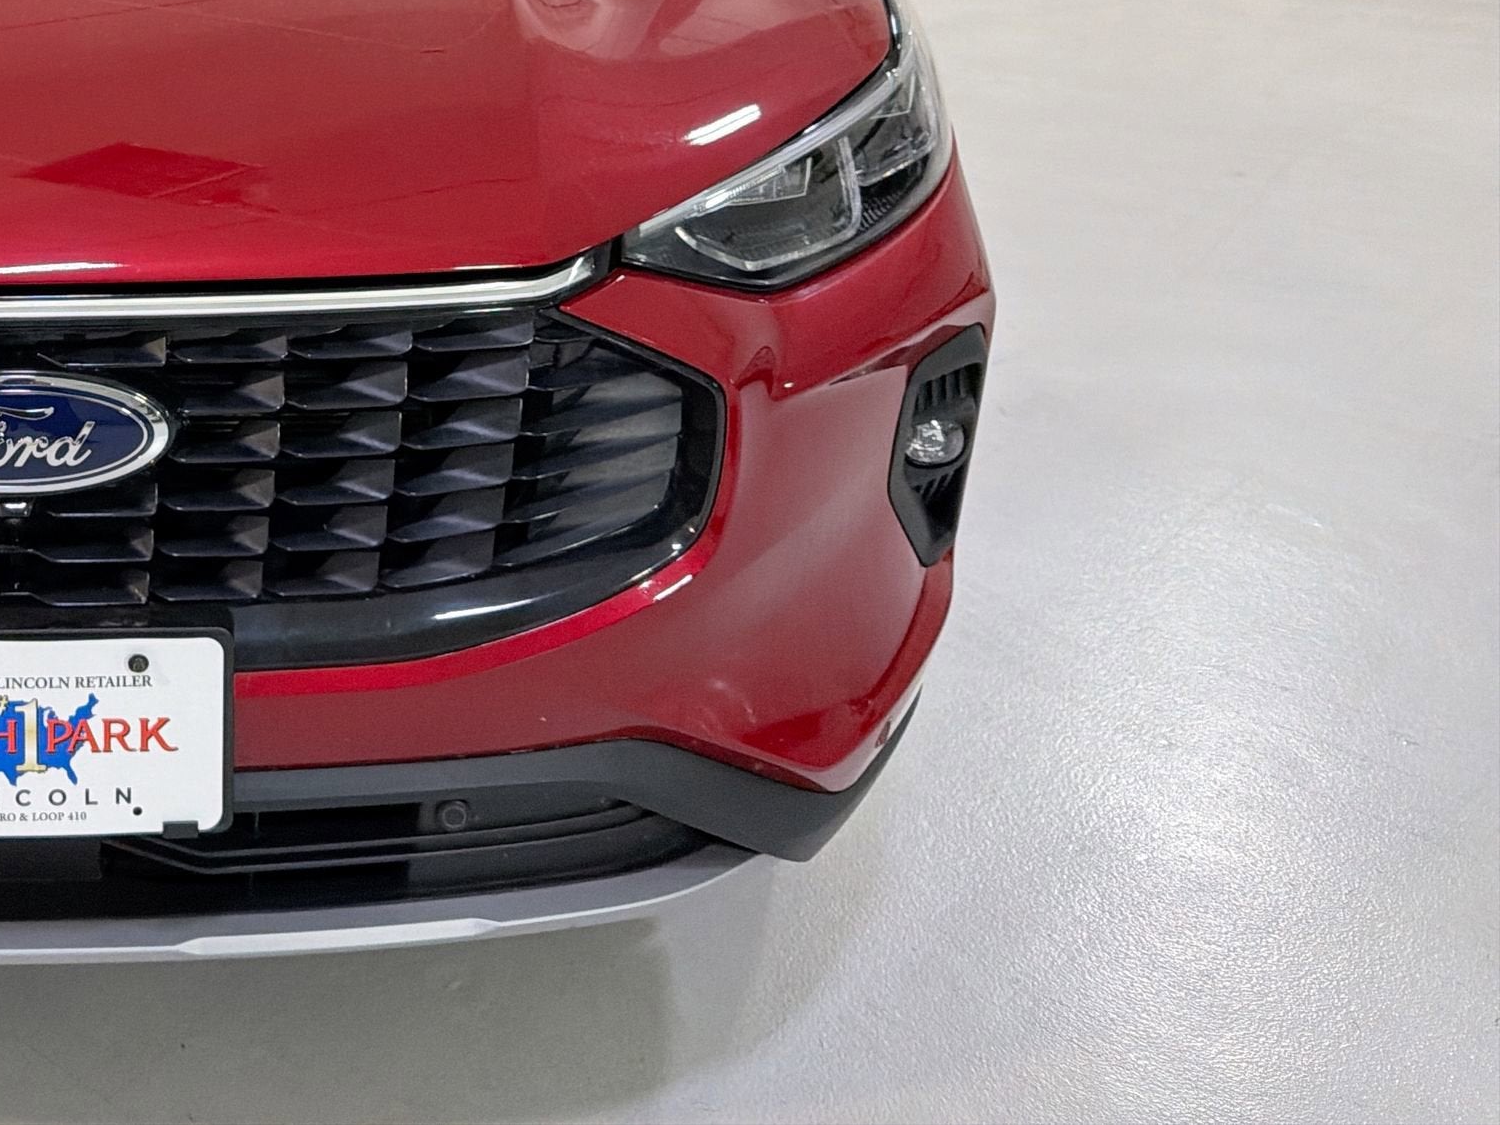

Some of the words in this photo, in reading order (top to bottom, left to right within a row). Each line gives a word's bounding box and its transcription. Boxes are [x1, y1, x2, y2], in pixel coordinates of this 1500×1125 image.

[75, 675, 153, 689] RETAILER
[46, 717, 179, 755] PARK
[19, 812, 29, 822] &
[32, 811, 65, 822] LOOP
[68, 811, 87, 821] 410
